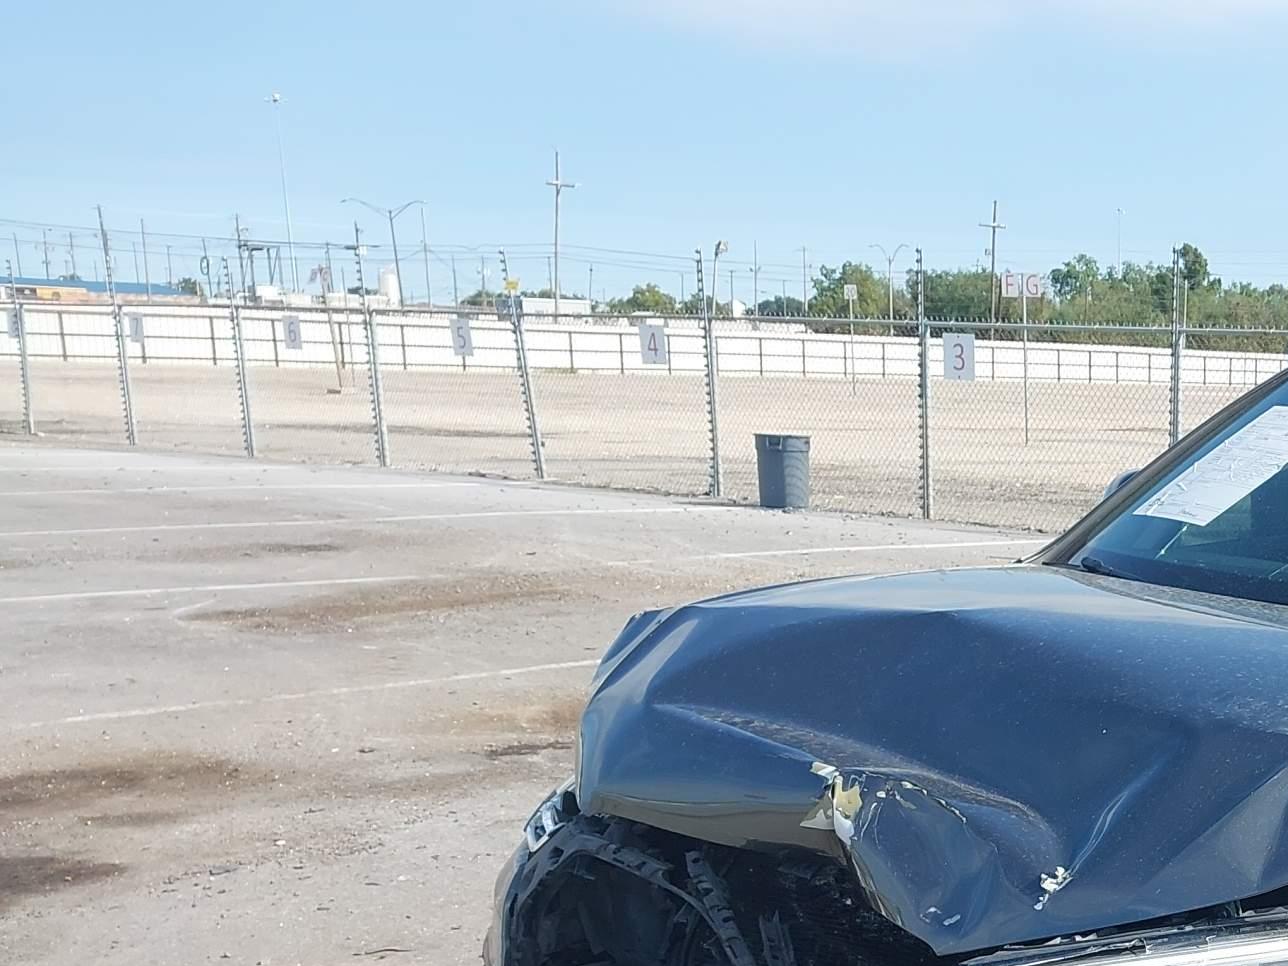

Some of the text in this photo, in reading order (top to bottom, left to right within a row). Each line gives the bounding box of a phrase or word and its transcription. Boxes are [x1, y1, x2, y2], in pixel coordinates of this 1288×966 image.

[1005, 274, 1014, 295] F
[1026, 274, 1039, 296] G
[287, 321, 297, 344] 6
[457, 326, 467, 350] 5
[648, 331, 659, 358] 4
[952, 343, 966, 372] 3
